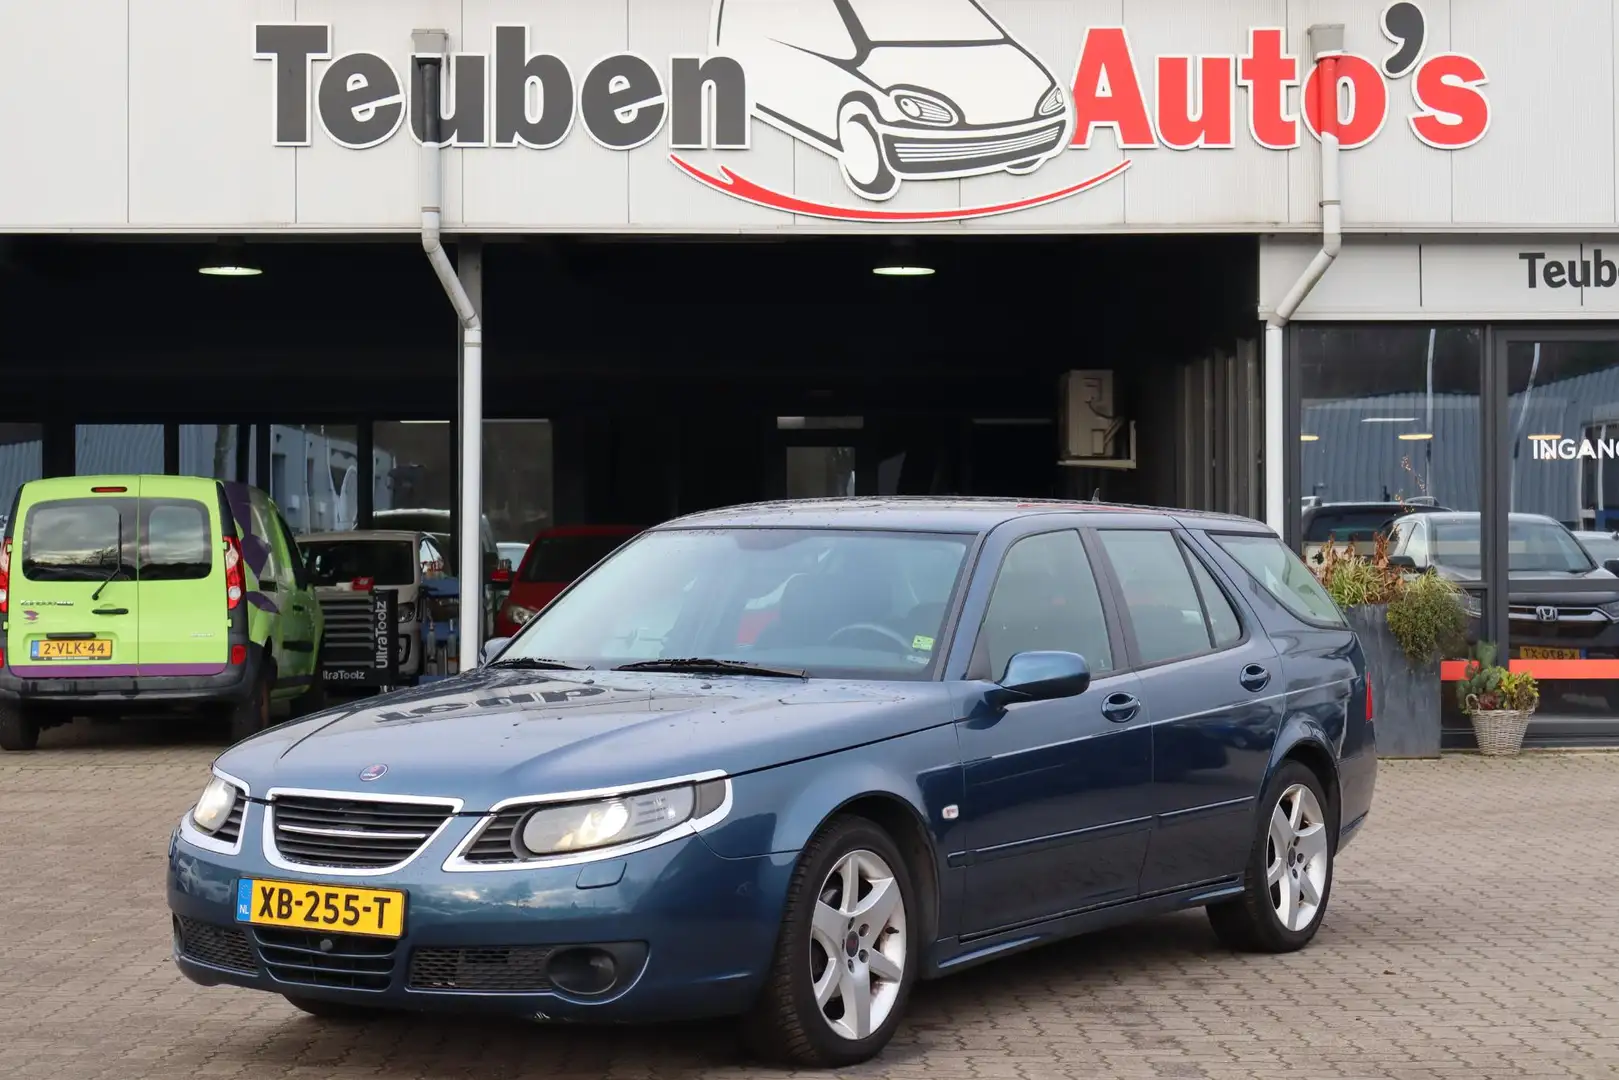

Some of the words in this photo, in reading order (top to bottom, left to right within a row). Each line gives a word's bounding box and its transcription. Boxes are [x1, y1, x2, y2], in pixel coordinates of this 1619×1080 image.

[254, 24, 750, 149] Teuben
[1069, 2, 1490, 149] Auto's
[1519, 249, 1619, 288] Teub
[43, 643, 105, 655] 2-VLK-44
[375, 601, 388, 668] UltraToolz
[322, 670, 365, 680] ltraToolz
[239, 904, 249, 915] NL
[258, 886, 391, 929] XB-255-T
